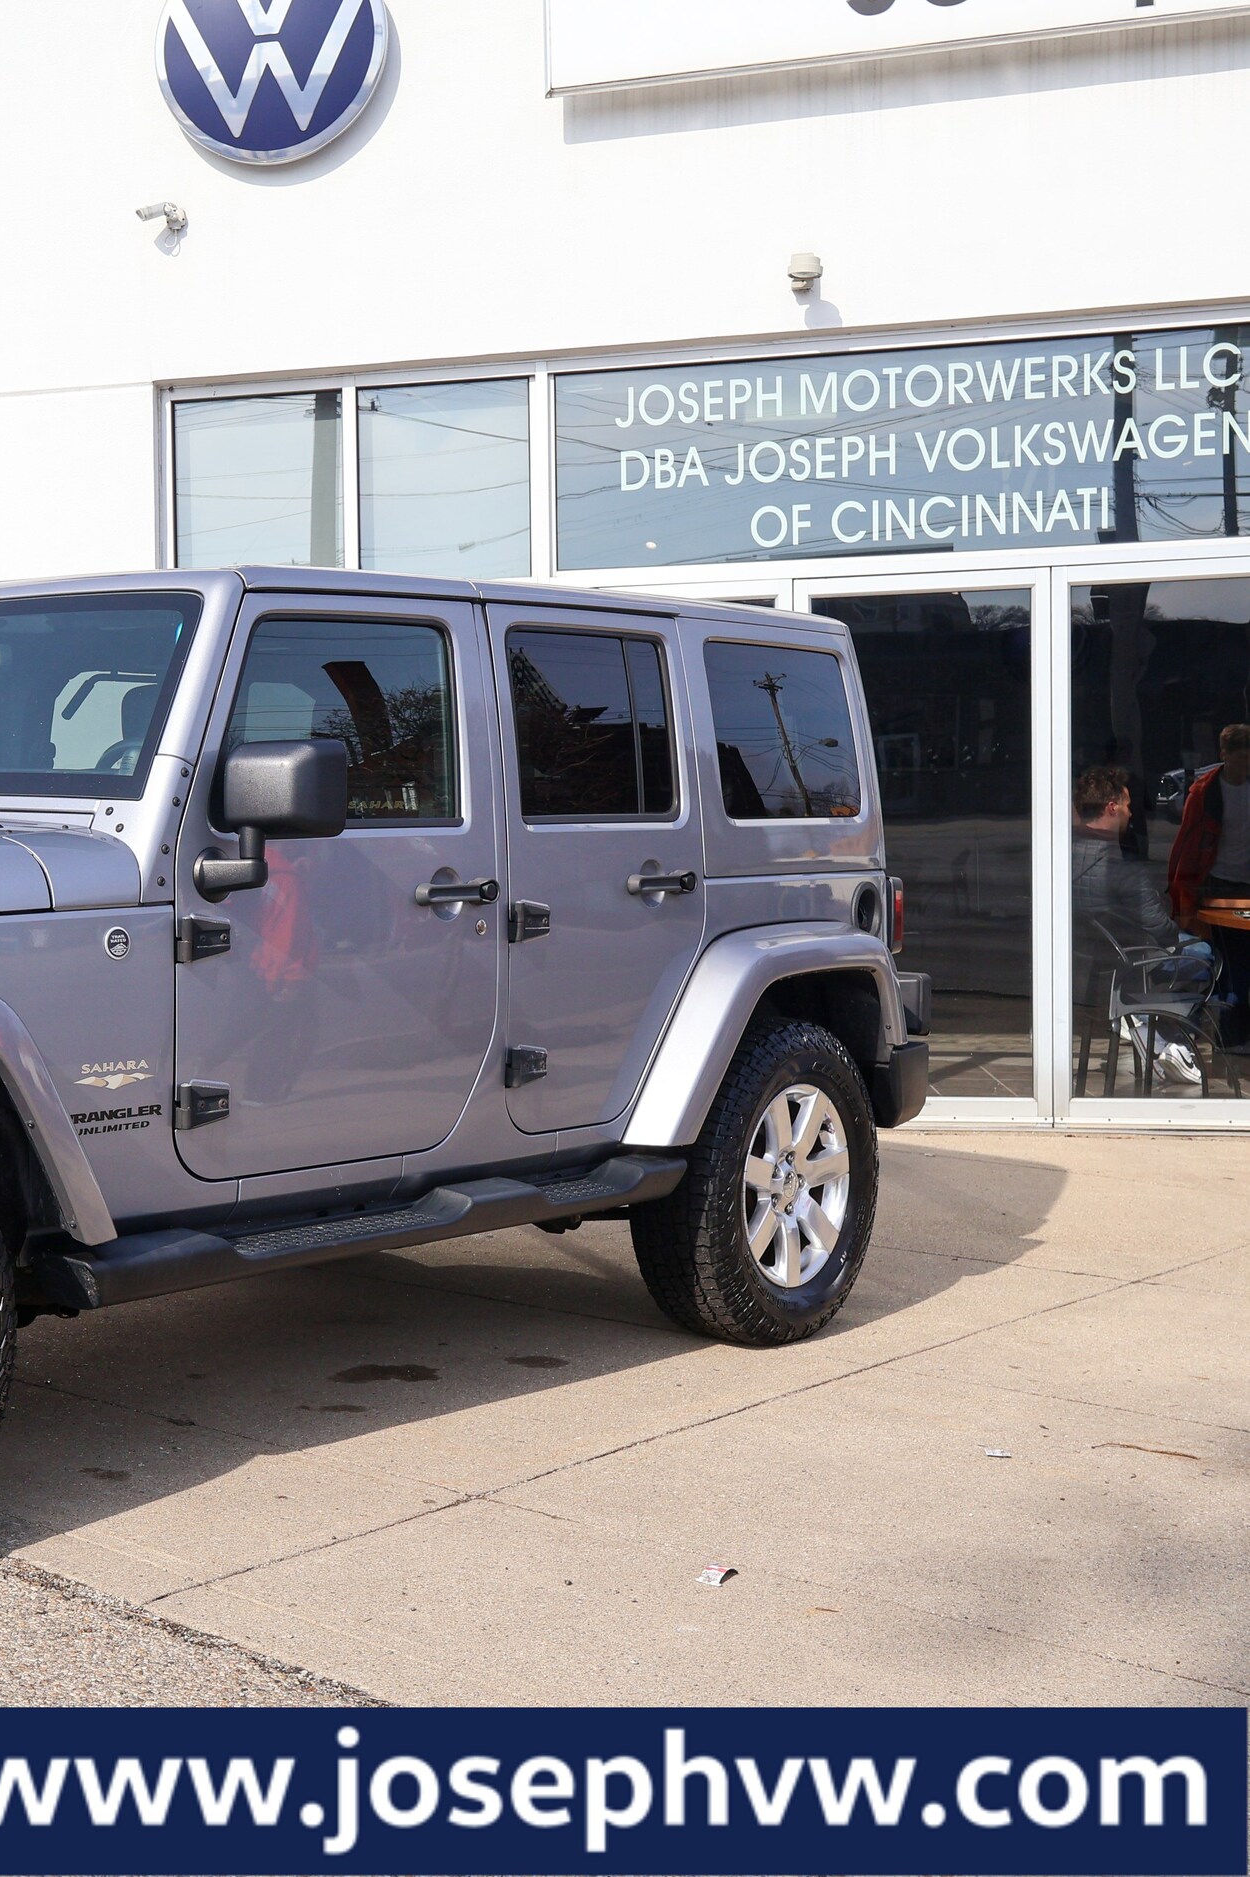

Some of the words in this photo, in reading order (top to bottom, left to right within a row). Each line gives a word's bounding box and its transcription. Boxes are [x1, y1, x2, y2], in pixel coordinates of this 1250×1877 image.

[615, 376, 782, 428] JOSEPH
[800, 350, 1136, 415] MOTORWERKS
[1155, 342, 1242, 391] LLC
[620, 446, 710, 491] DBA
[724, 433, 896, 486] JOSEPH
[914, 409, 1250, 473] VOLKSWAGEN
[750, 503, 812, 548] OF
[831, 486, 1109, 543] CINCINNATI
[81, 1059, 149, 1074] SAHARA
[70, 1104, 162, 1124] RANGLER
